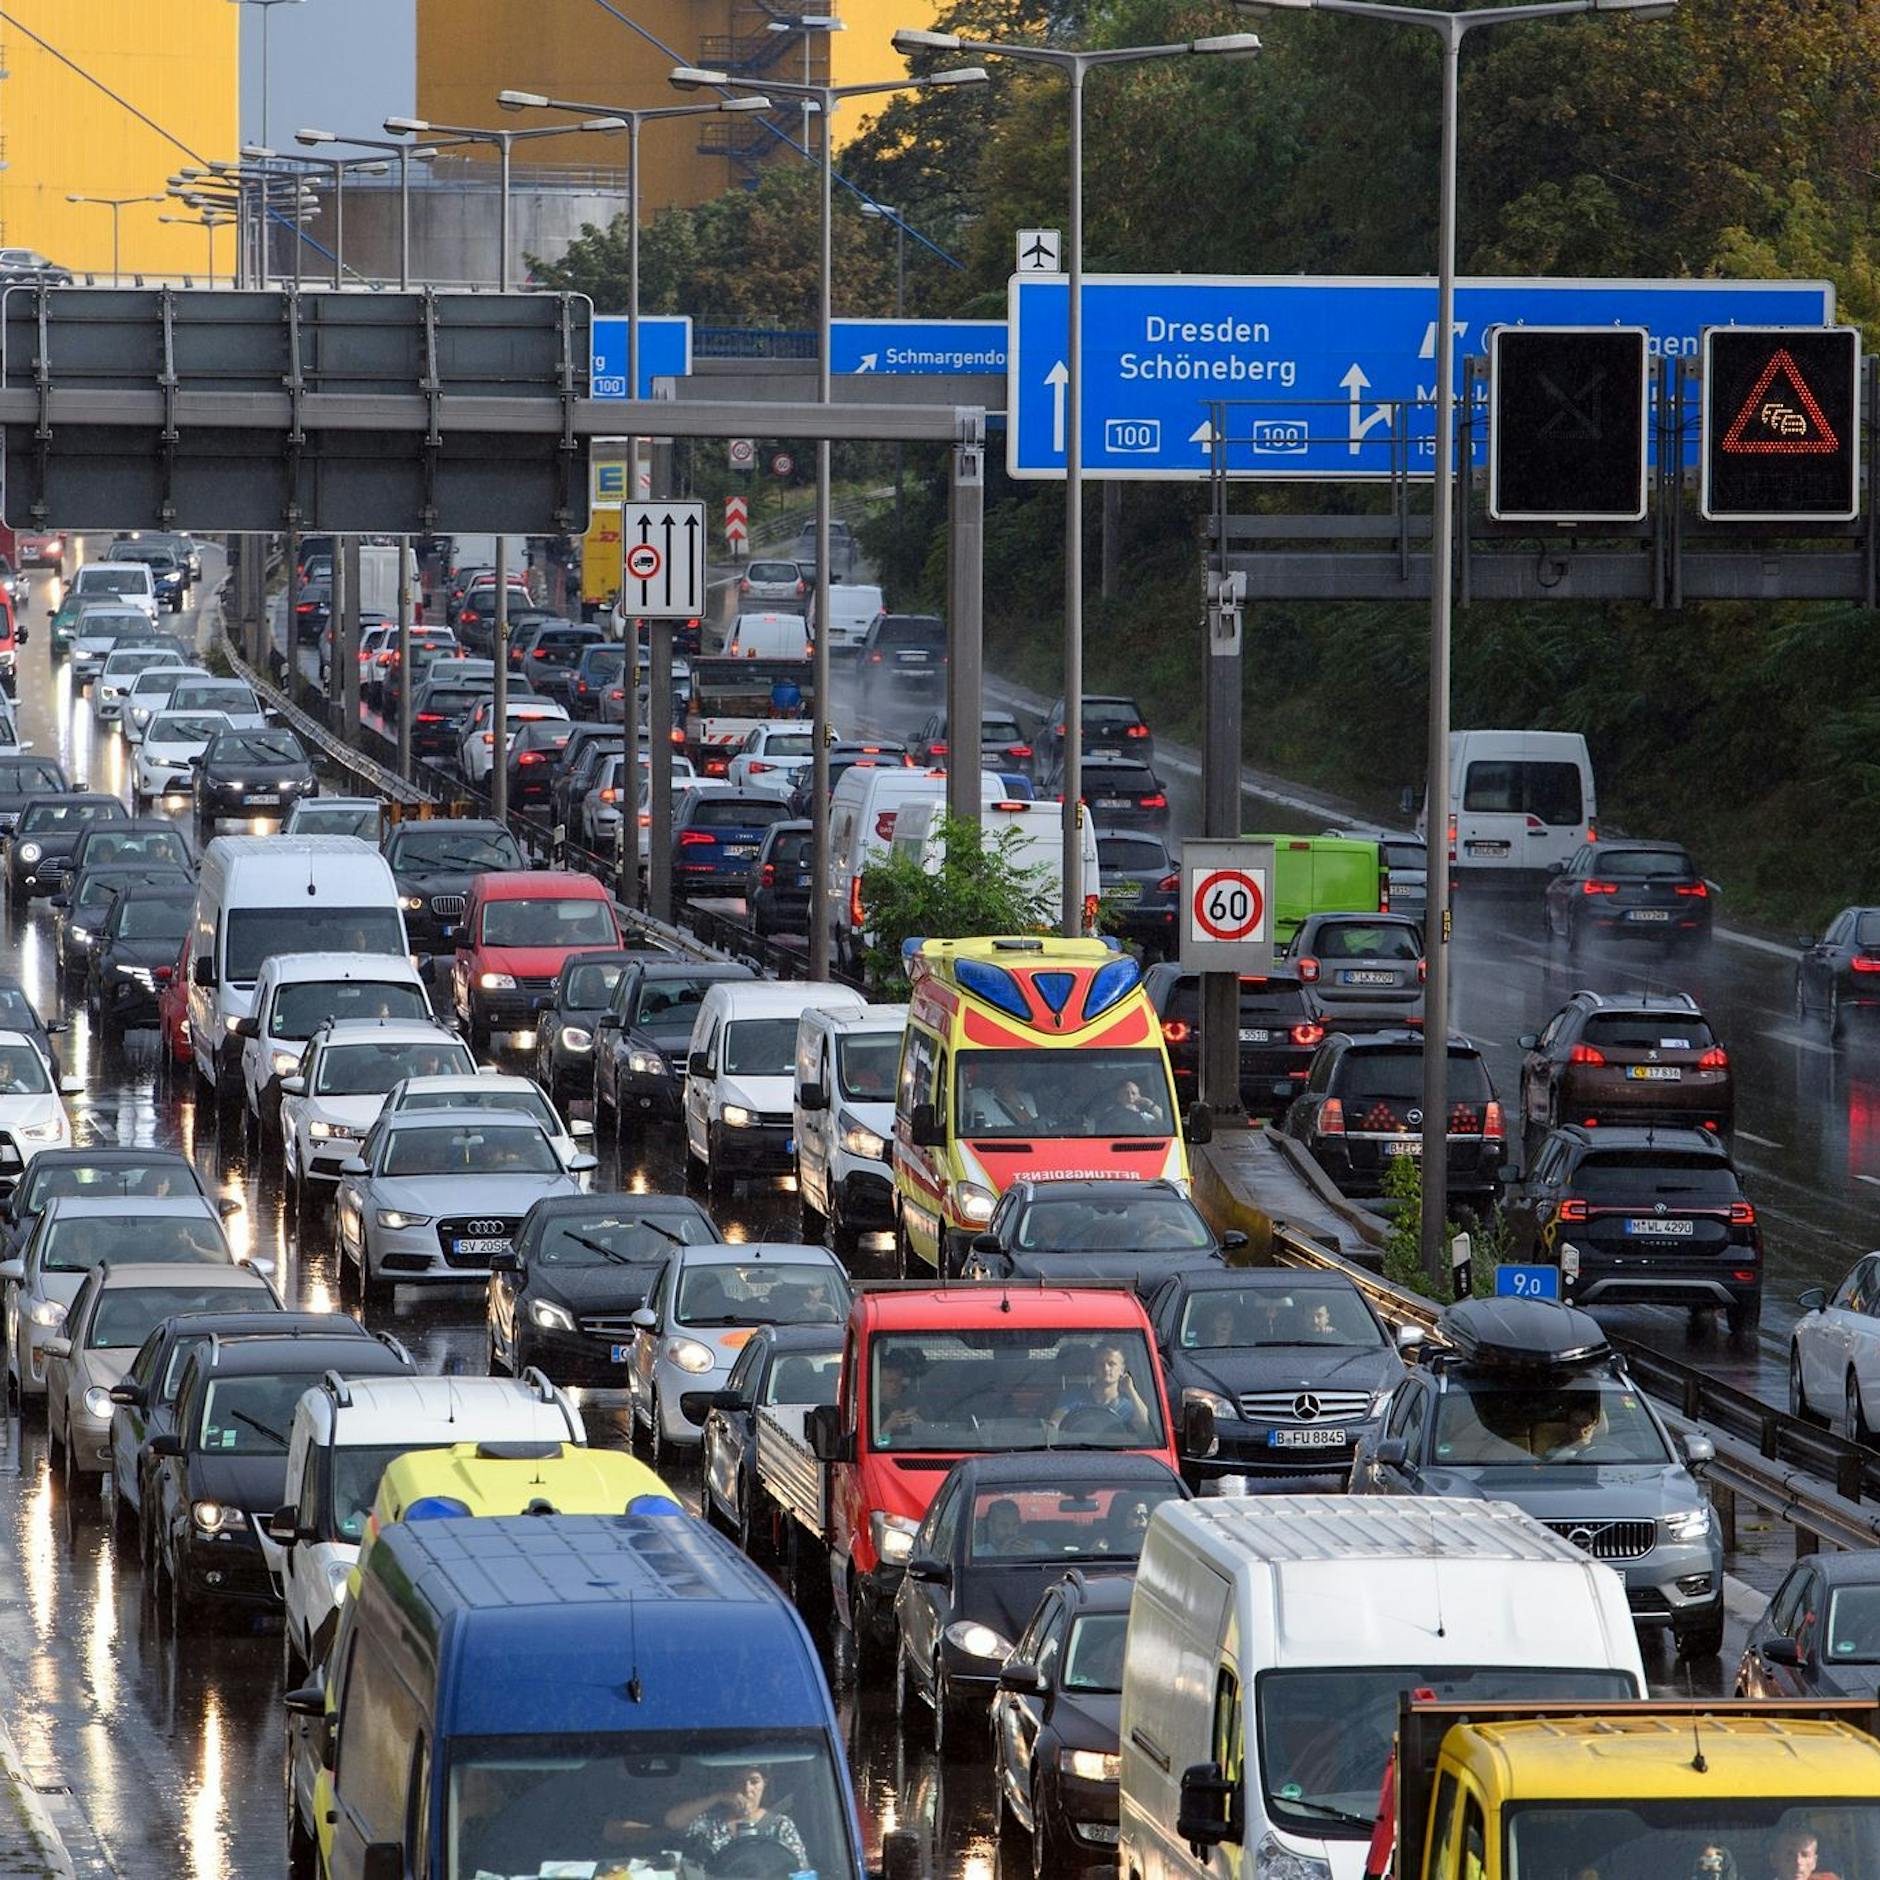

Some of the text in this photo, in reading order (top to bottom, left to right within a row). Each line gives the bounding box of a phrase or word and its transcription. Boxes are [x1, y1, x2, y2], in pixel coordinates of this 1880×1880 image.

[1146, 316, 1270, 342] Dresden
[886, 348, 1008, 368] Schmargendo
[1119, 353, 1296, 387] Schöneberg
[598, 380, 620, 392] 100
[1114, 426, 1150, 445] 100
[1263, 428, 1299, 447] 100
[1210, 890, 1247, 921] 60
[460, 1241, 476, 1251] SV
[1513, 1273, 1541, 1295] 9,0
[1277, 1431, 1344, 1444] B FU 8845
